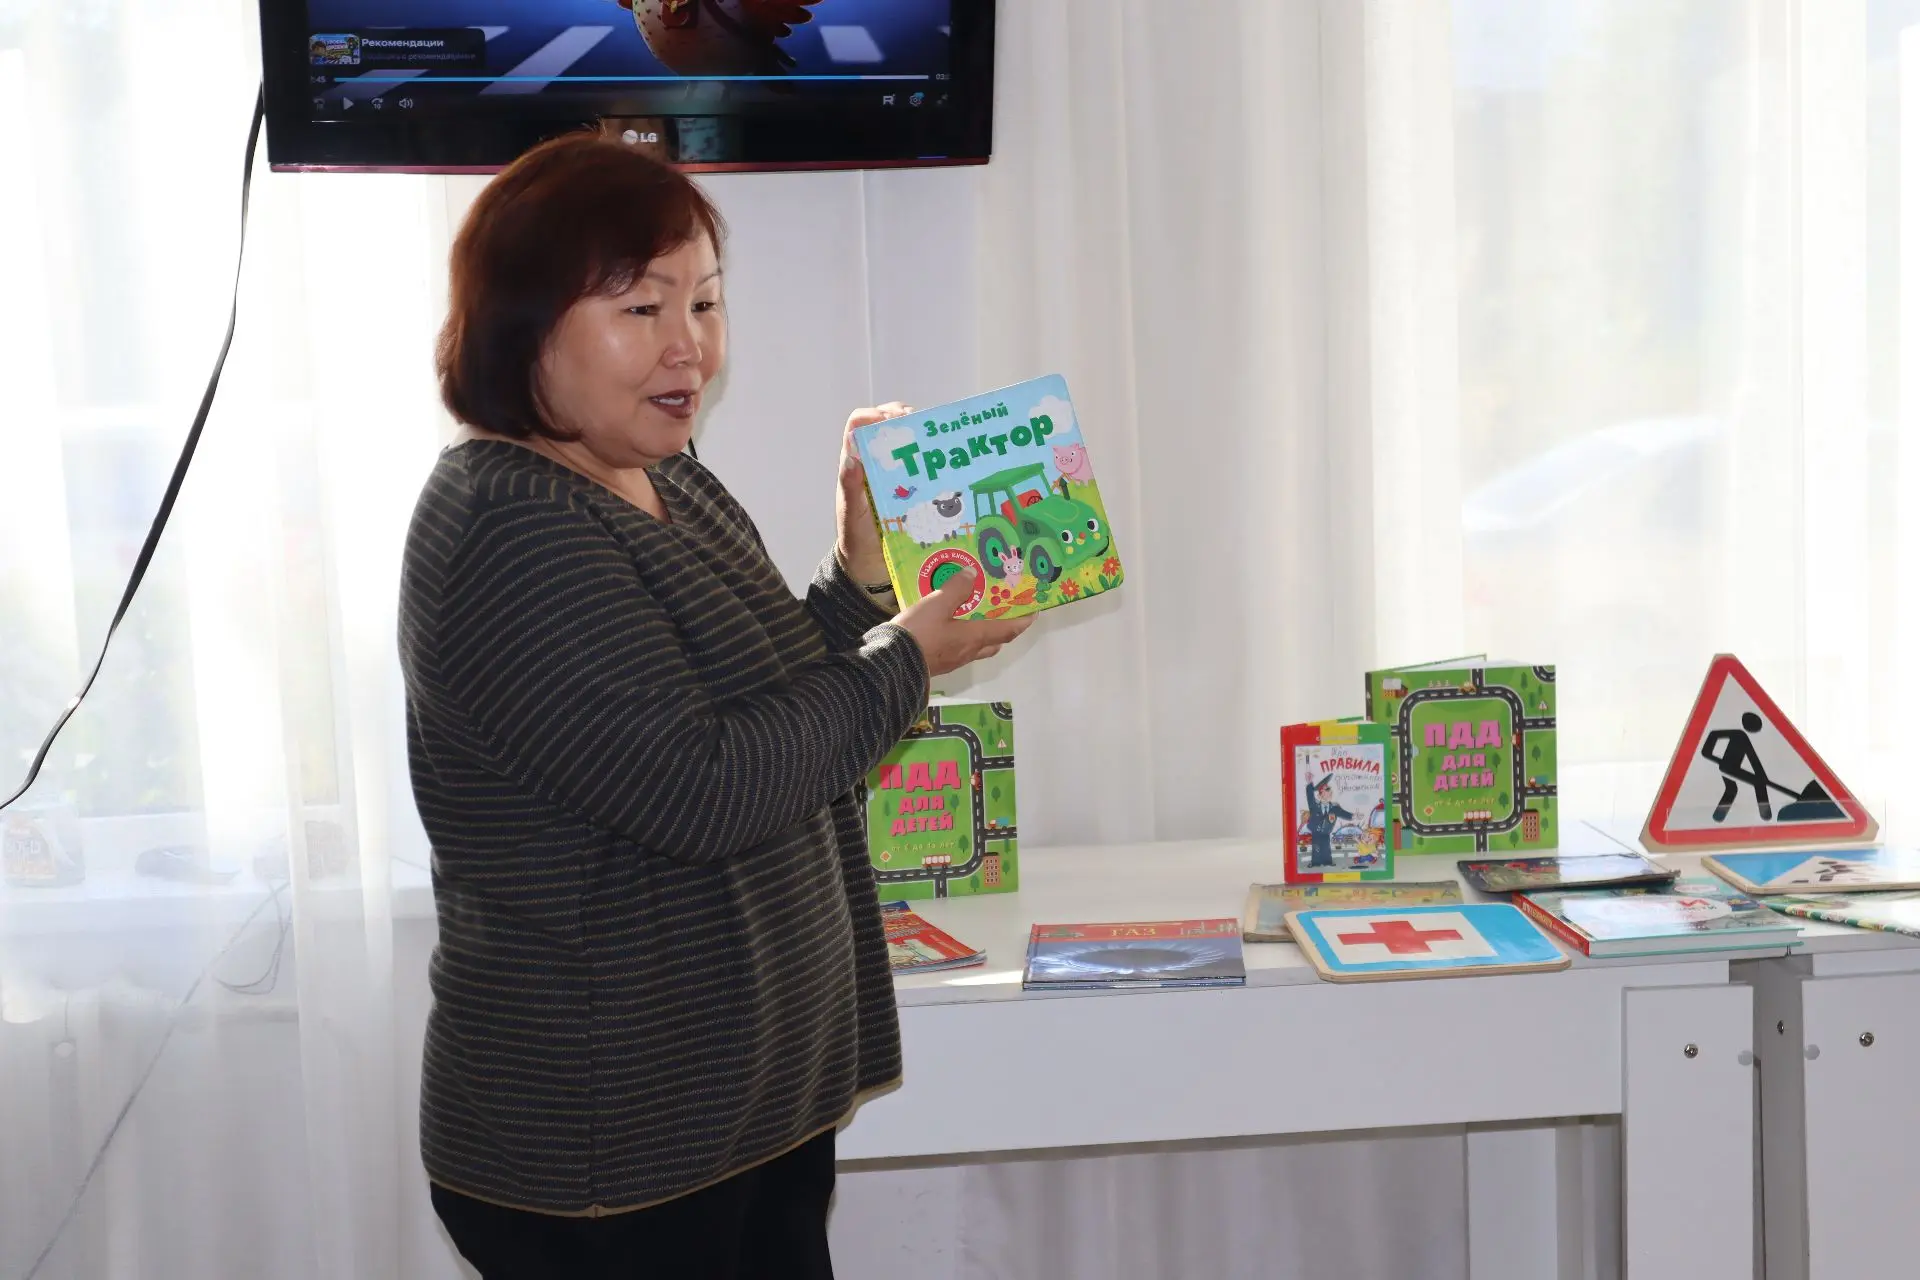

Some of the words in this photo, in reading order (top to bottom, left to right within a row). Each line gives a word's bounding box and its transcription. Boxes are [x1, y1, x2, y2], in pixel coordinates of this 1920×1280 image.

[361, 38, 444, 48] Рекомендации
[639, 132, 657, 143] LG
[923, 401, 1009, 438] Зелёный
[890, 413, 1054, 481] Трактор
[920, 557, 939, 578] Нажми
[951, 552, 976, 567] кнопку
[1423, 719, 1504, 750] ПДД
[1319, 757, 1381, 775] ПРАВИЛА
[1441, 753, 1486, 771] ДЛЯ
[880, 761, 962, 792] ПДД
[1433, 770, 1495, 792] ДЕТЕЙ
[898, 795, 945, 816] ДЛЯ
[890, 812, 954, 837] ДЕТЕЙ
[1110, 926, 1157, 937] ГАЗ
